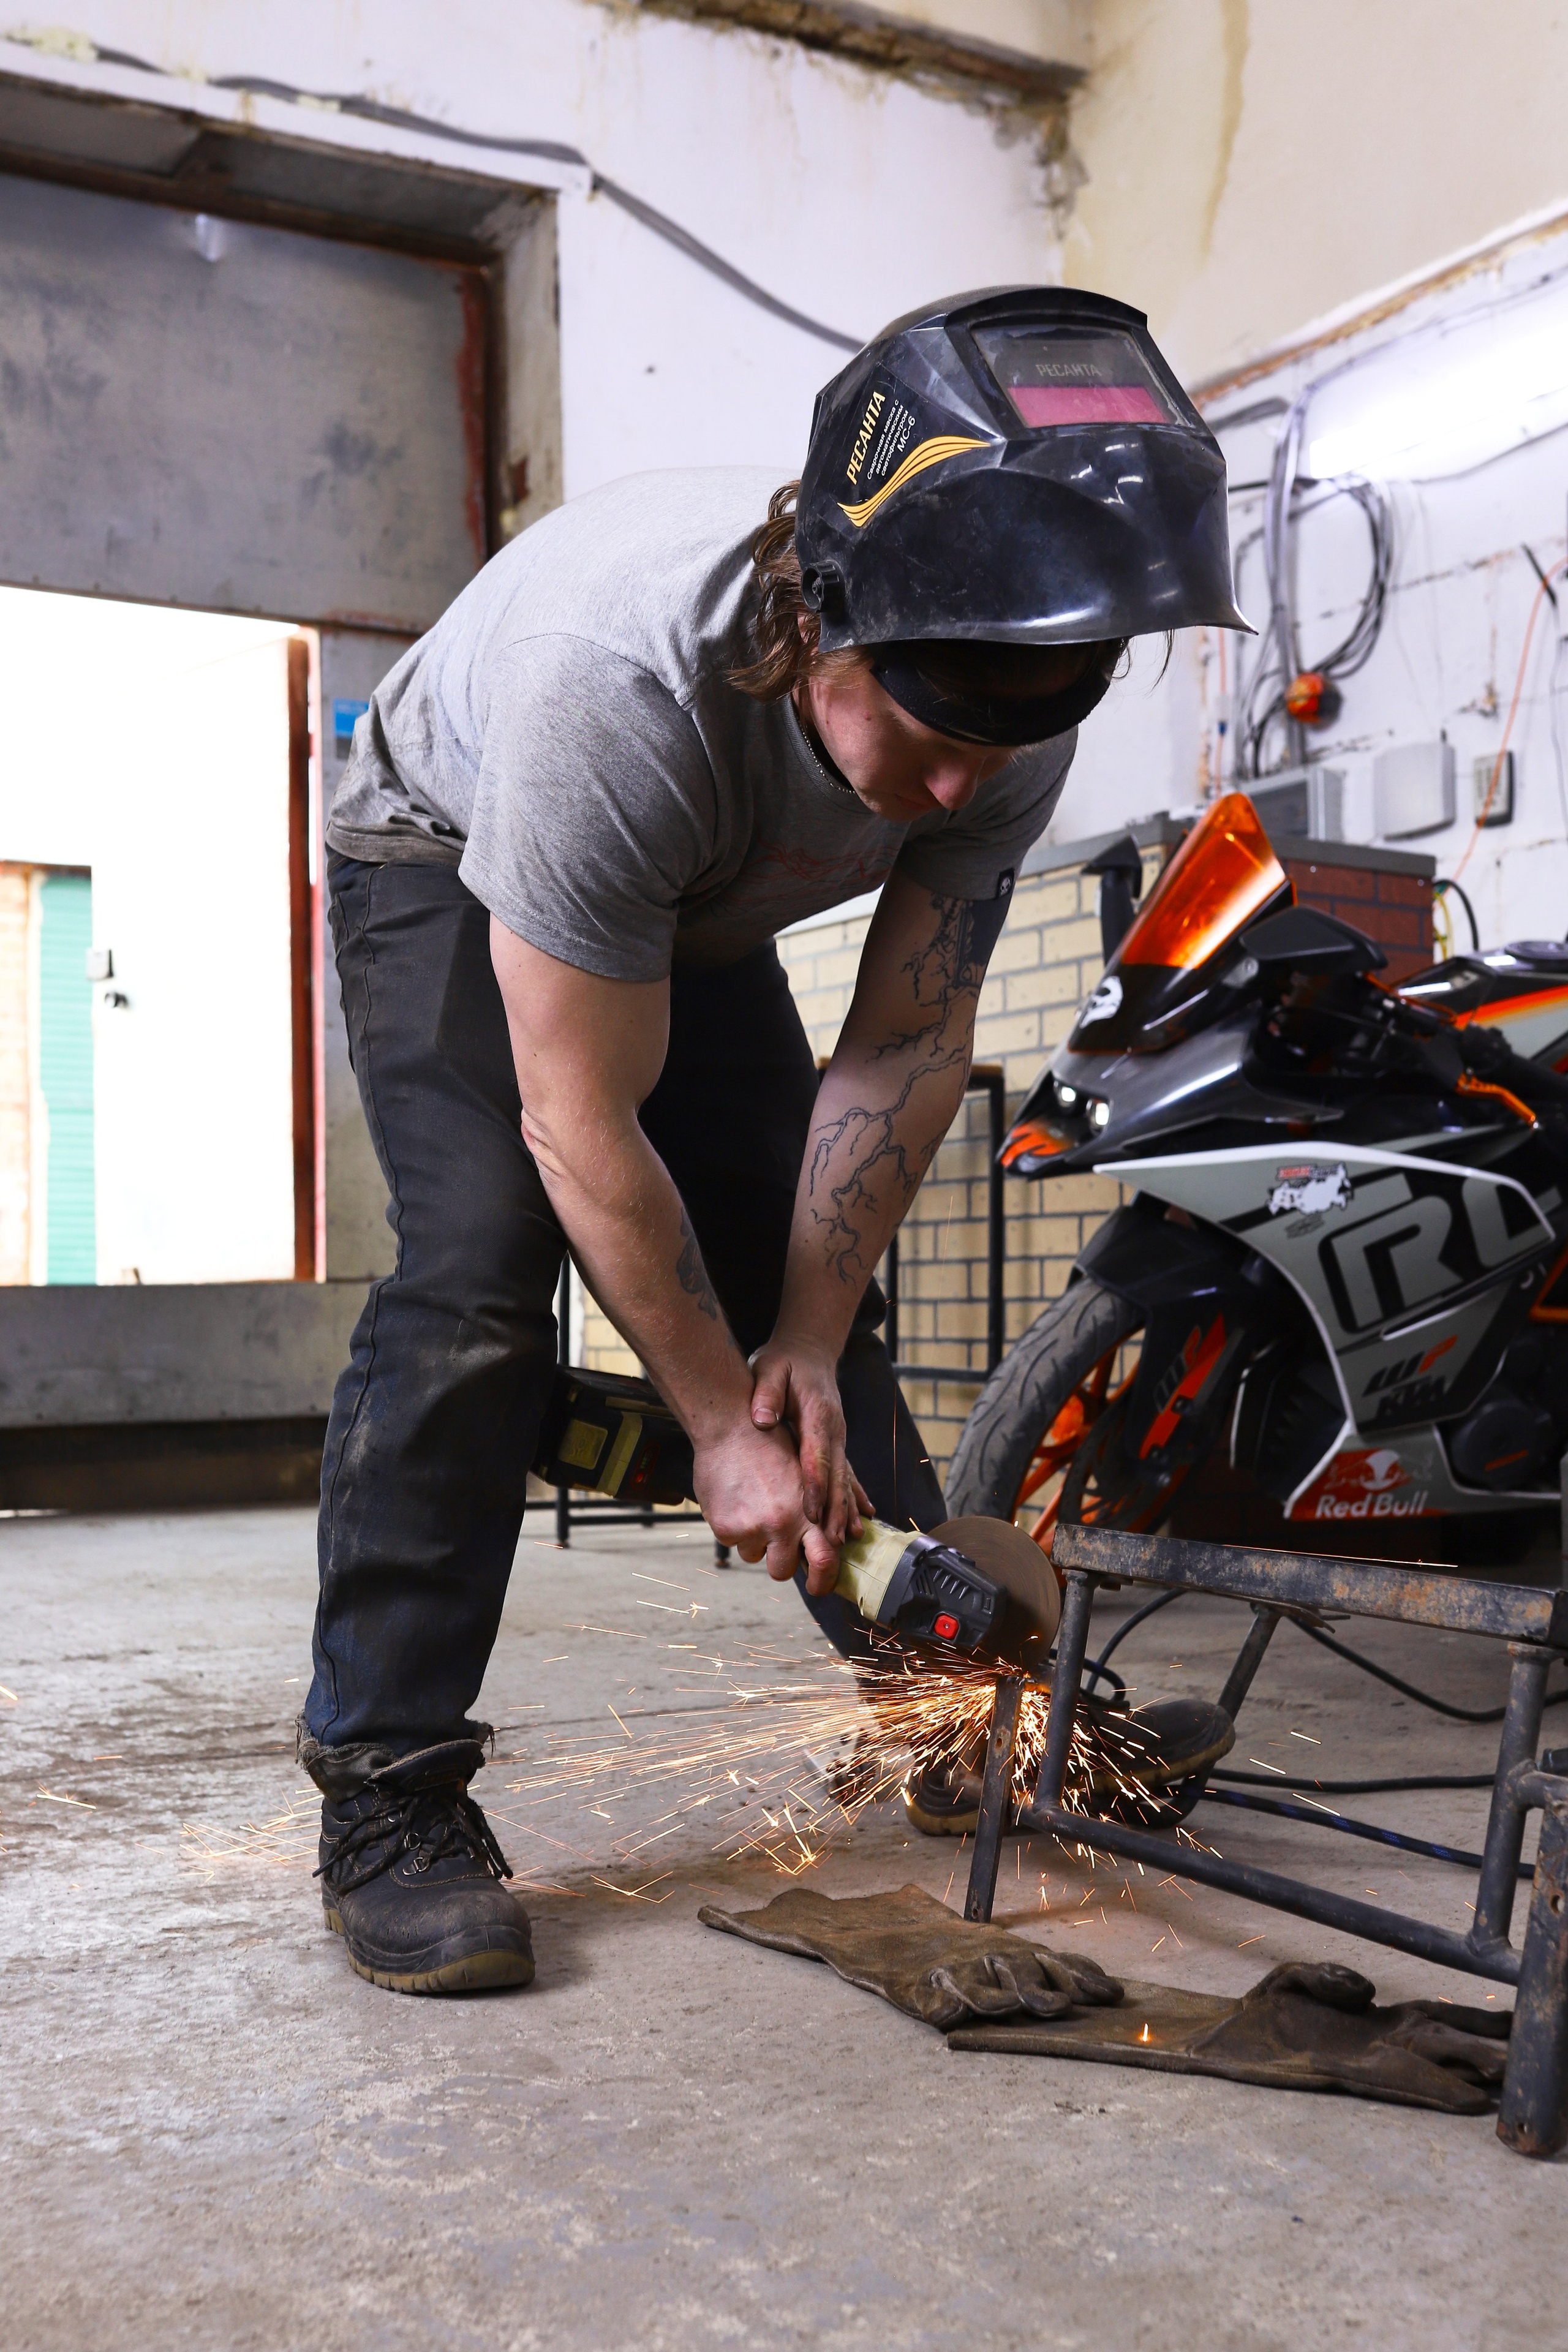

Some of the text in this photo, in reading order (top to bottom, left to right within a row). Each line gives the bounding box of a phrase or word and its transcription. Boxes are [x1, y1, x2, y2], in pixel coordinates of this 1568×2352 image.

[1035, 363, 1102, 377] РЕСАНТА
[846, 391, 886, 485] РЕСАНТА
[867, 434, 886, 480] Сварочная
[884, 407, 896, 434] маска
[875, 404, 905, 475] автоматическим
[881, 410, 909, 477] светофильтром
[1314, 1489, 1429, 1520] Red Bull
